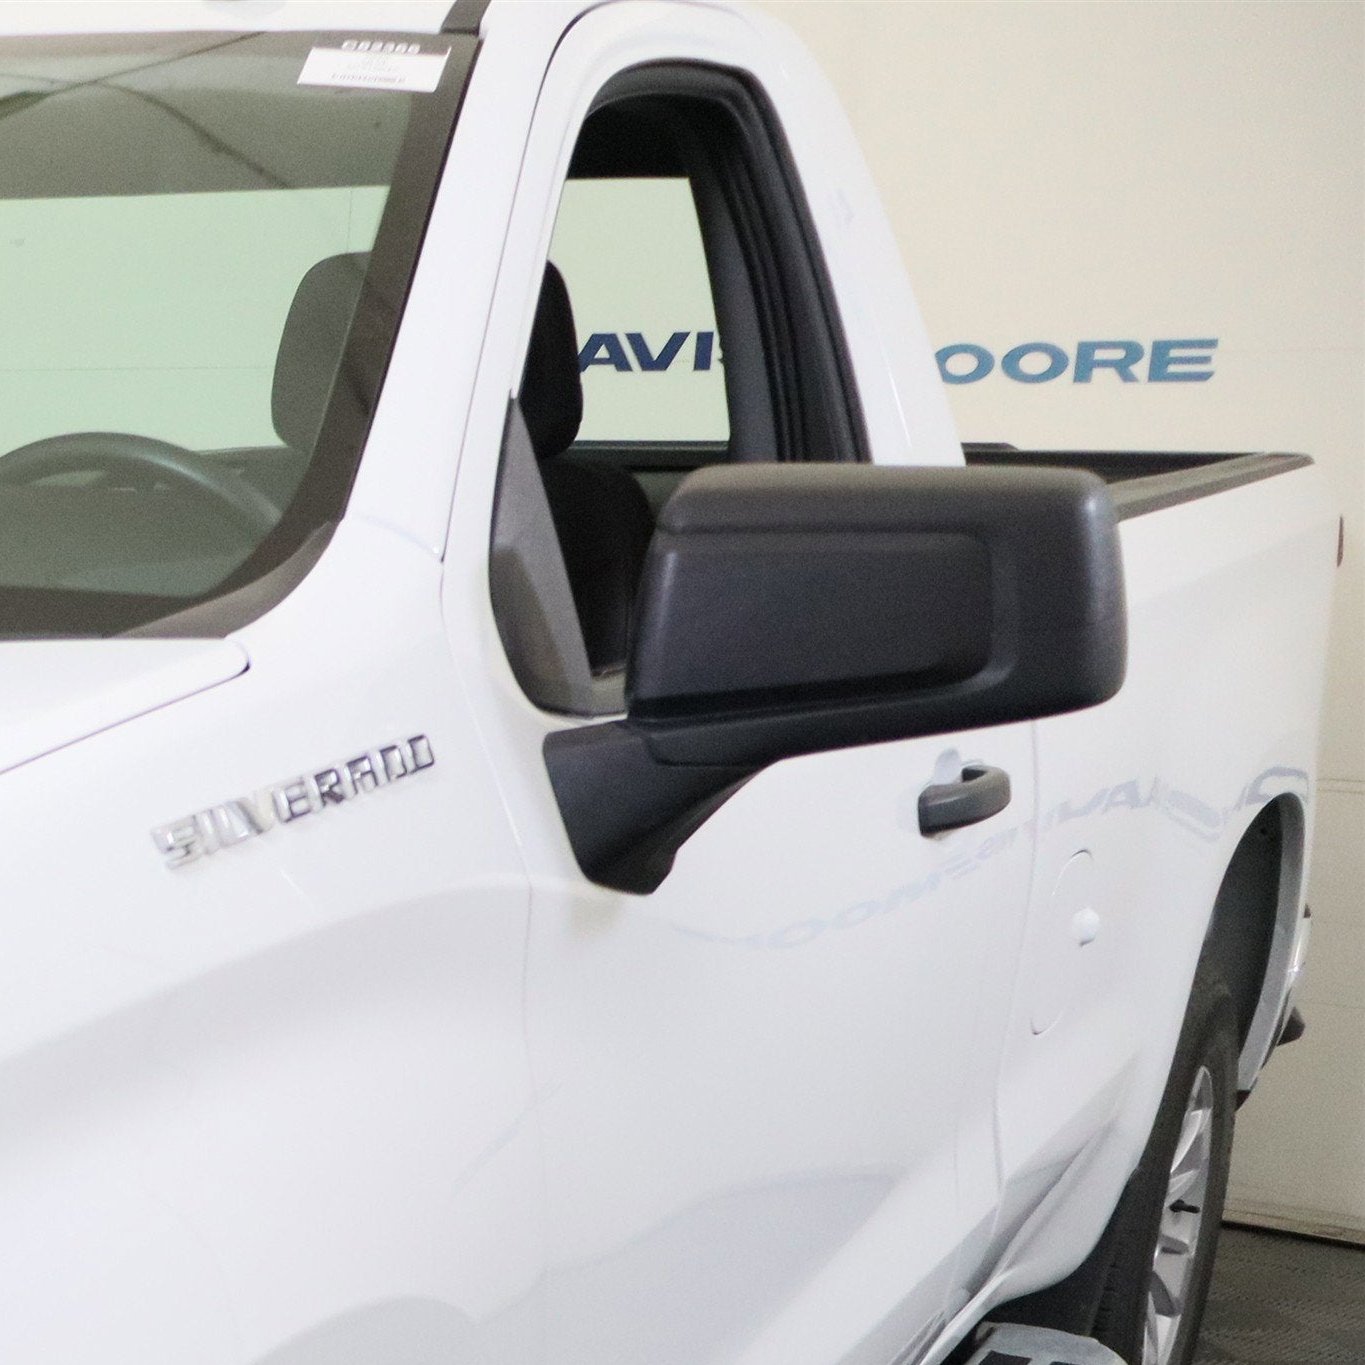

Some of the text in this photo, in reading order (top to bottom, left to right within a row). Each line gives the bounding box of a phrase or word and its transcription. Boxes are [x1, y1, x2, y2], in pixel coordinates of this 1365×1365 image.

[578, 331, 1219, 385] AVI OORE
[150, 734, 435, 870] SILVERADO
